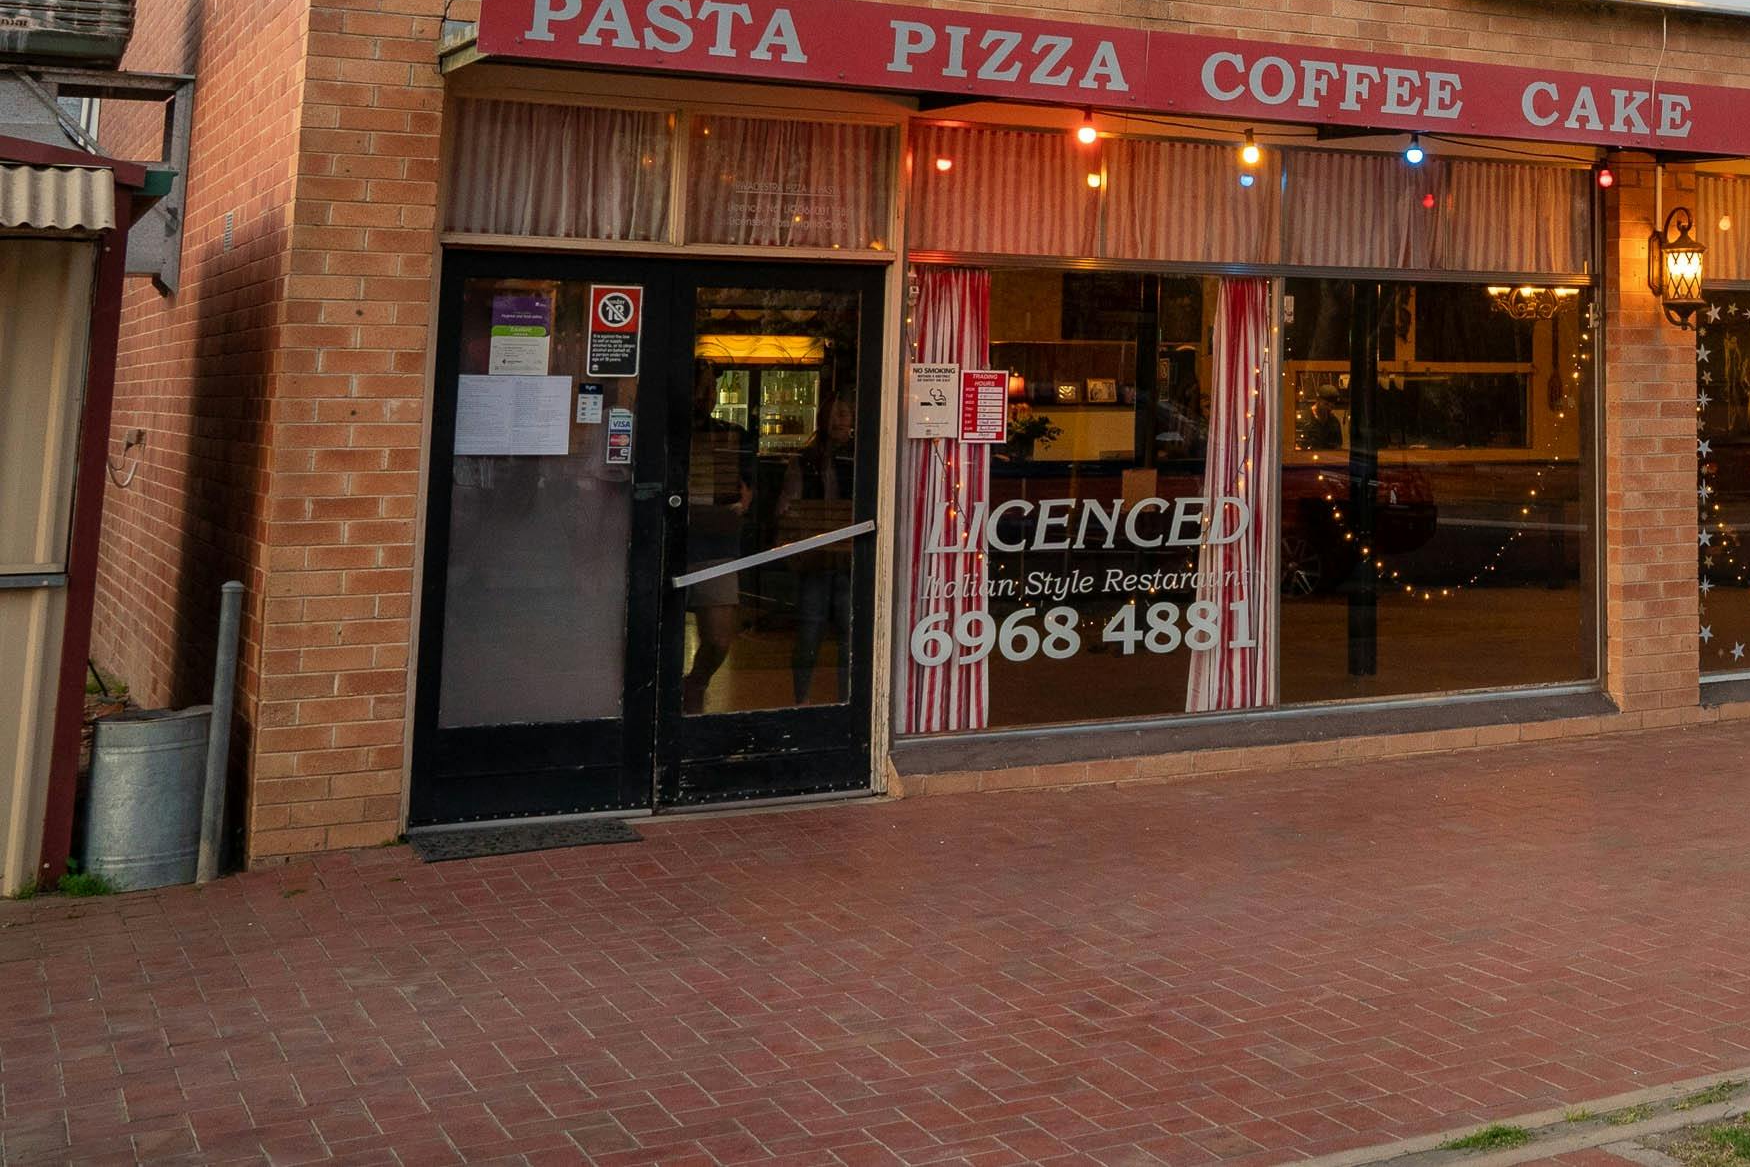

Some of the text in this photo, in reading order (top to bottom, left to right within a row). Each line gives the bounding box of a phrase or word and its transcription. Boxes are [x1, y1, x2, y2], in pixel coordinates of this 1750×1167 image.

[886, 20, 1129, 92] PIZZA
[1201, 51, 1464, 119] COFFEE
[1521, 81, 1692, 138] CAKE
[613, 420, 631, 428] VISA
[925, 496, 1250, 554] LICENCED
[921, 572, 1016, 601] Italian
[1025, 570, 1094, 601] Style
[910, 600, 1257, 667] 6968 4881
